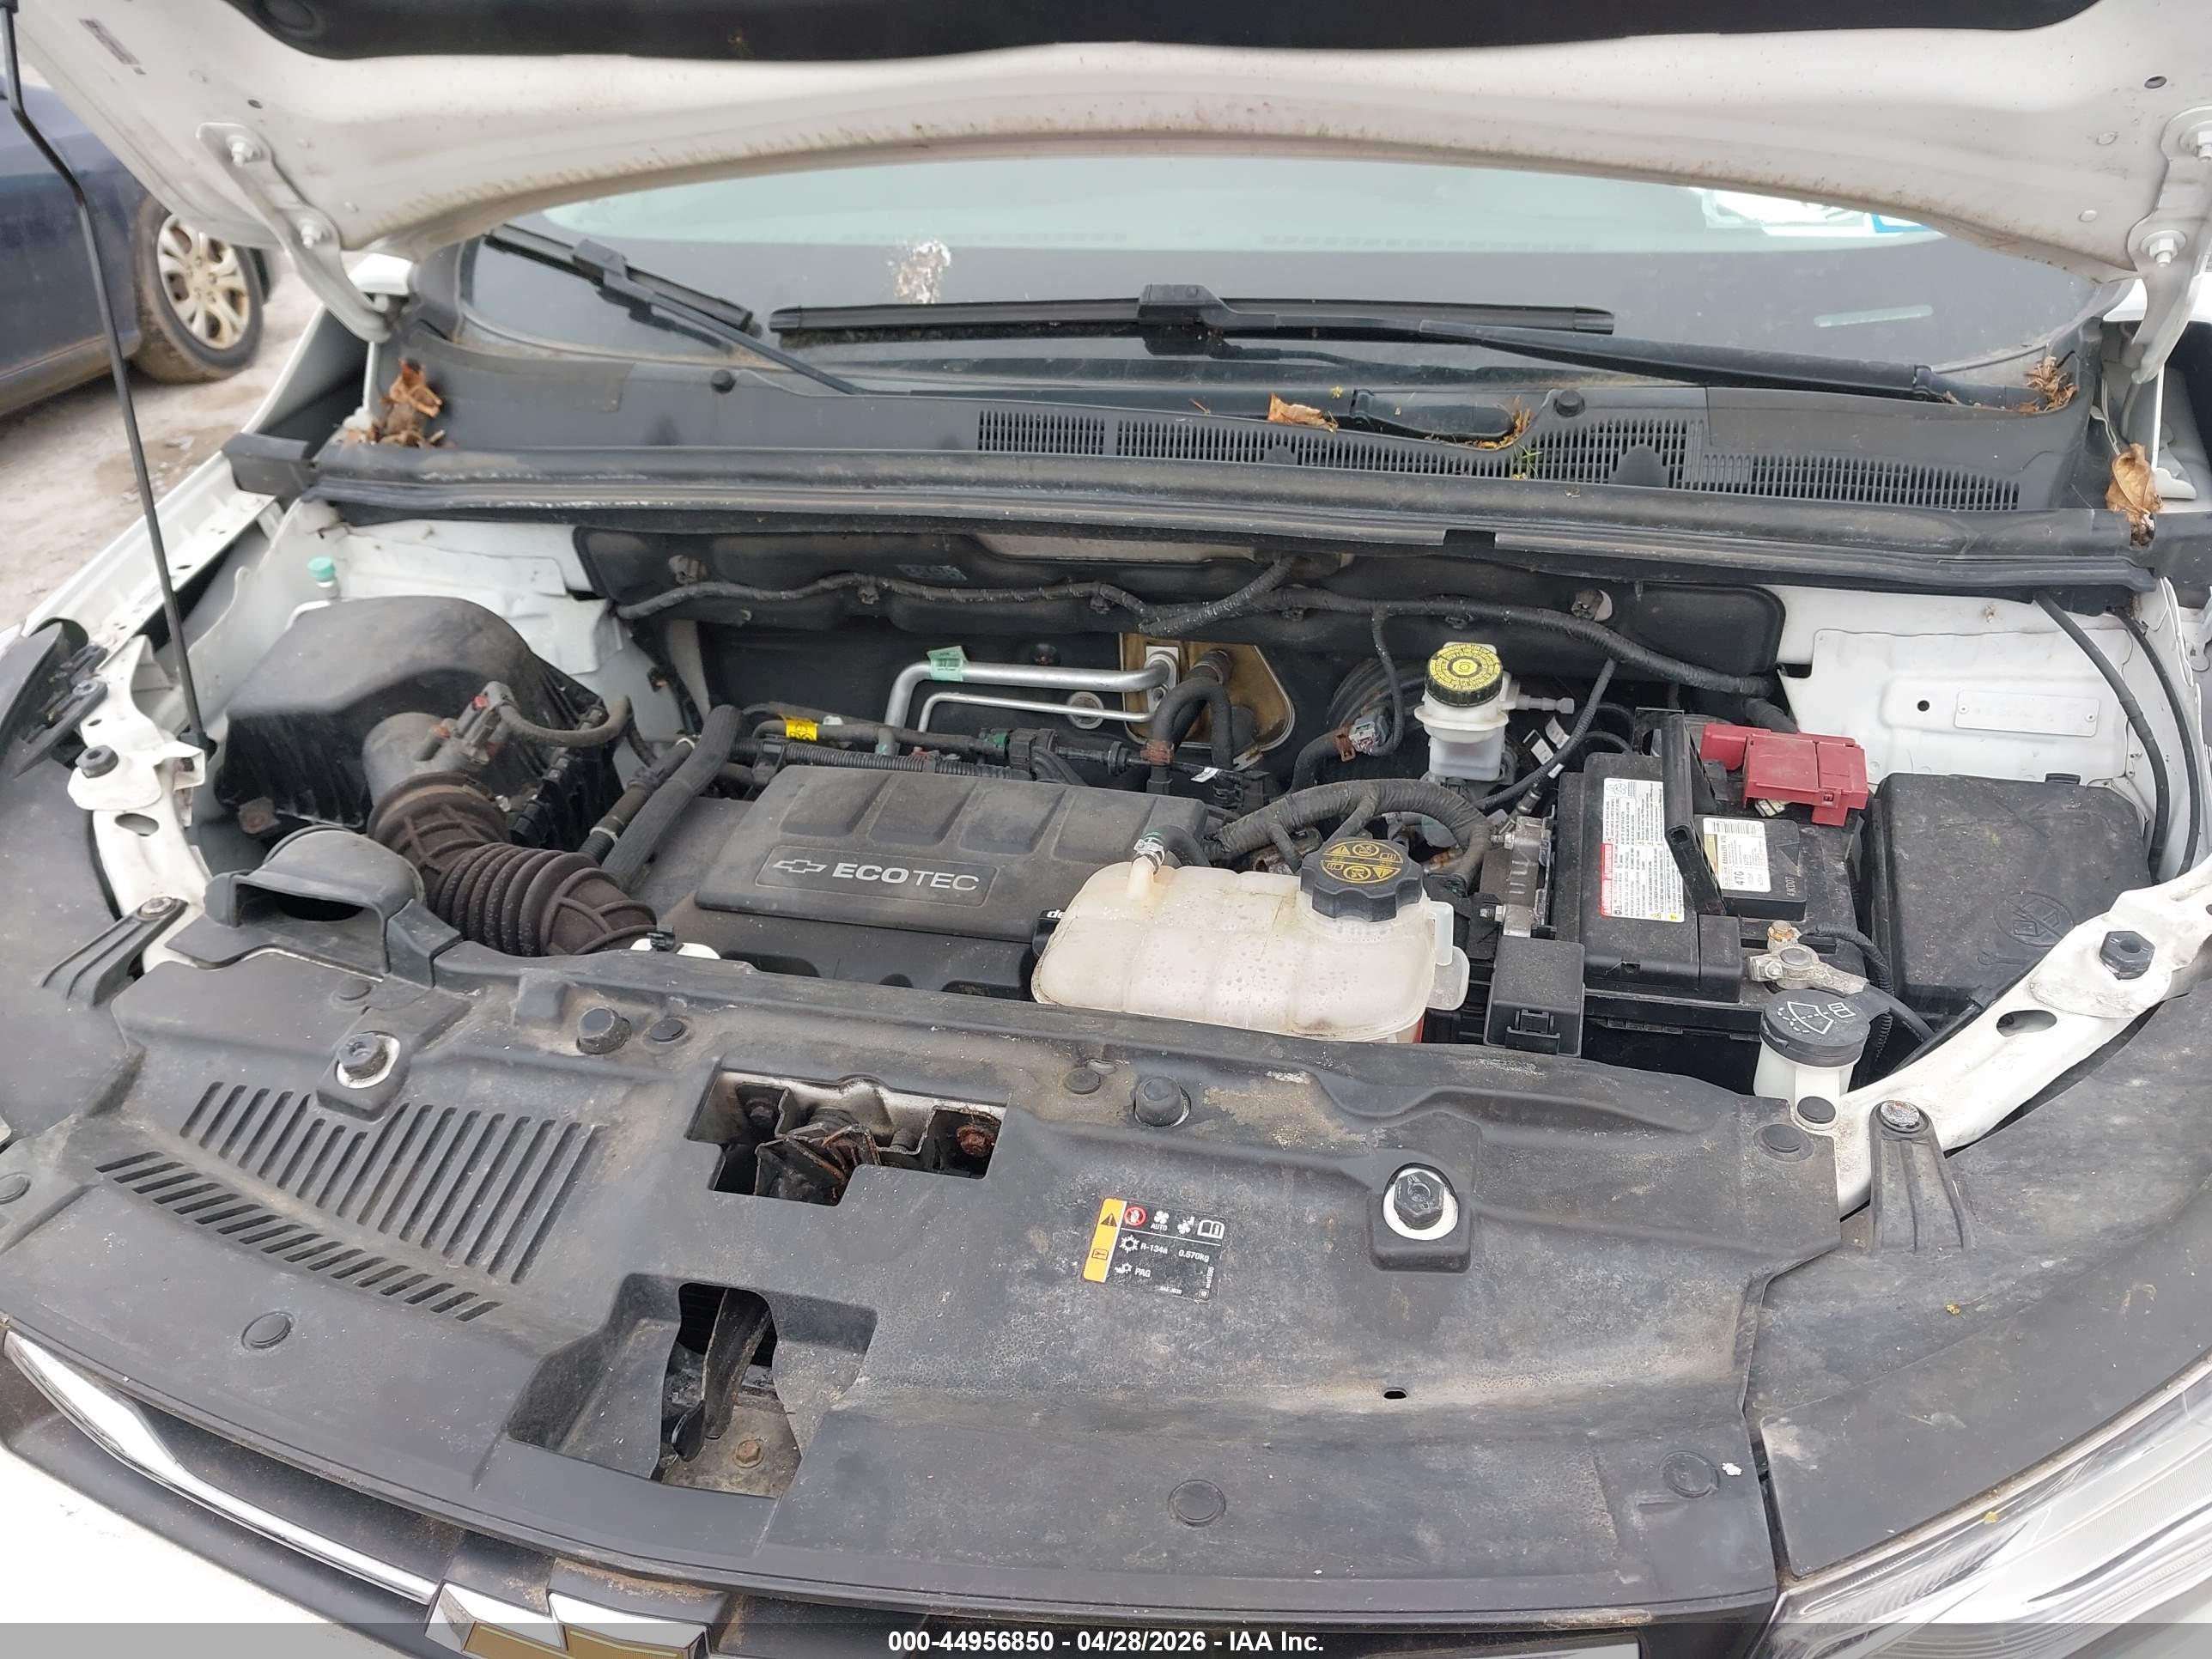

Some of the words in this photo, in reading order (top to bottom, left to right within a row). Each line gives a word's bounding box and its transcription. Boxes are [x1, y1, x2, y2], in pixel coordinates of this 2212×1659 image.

[832, 862, 980, 891] ECOTEC
[1150, 1223, 1168, 1231] AUTO
[1140, 1243, 1169, 1255] R-134a
[1178, 1249, 1210, 1263] 0.570kg
[1134, 1267, 1152, 1278] PAG
